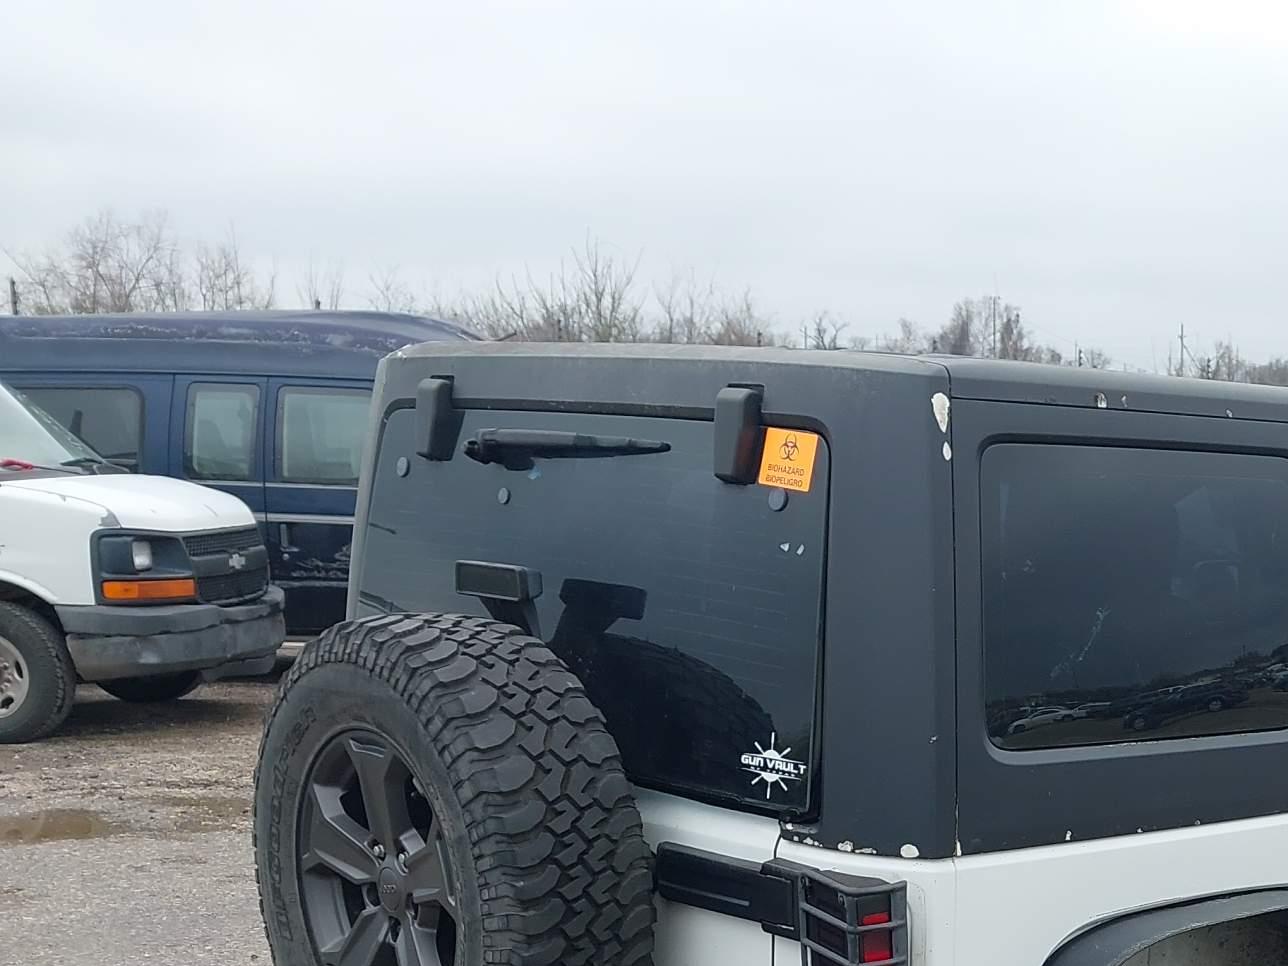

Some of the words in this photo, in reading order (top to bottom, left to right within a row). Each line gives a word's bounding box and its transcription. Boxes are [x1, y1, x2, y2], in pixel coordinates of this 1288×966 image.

[768, 463, 804, 477] BIOHAZARD
[766, 474, 803, 488] BIOPELIGRO
[766, 758, 807, 775] VAULT
